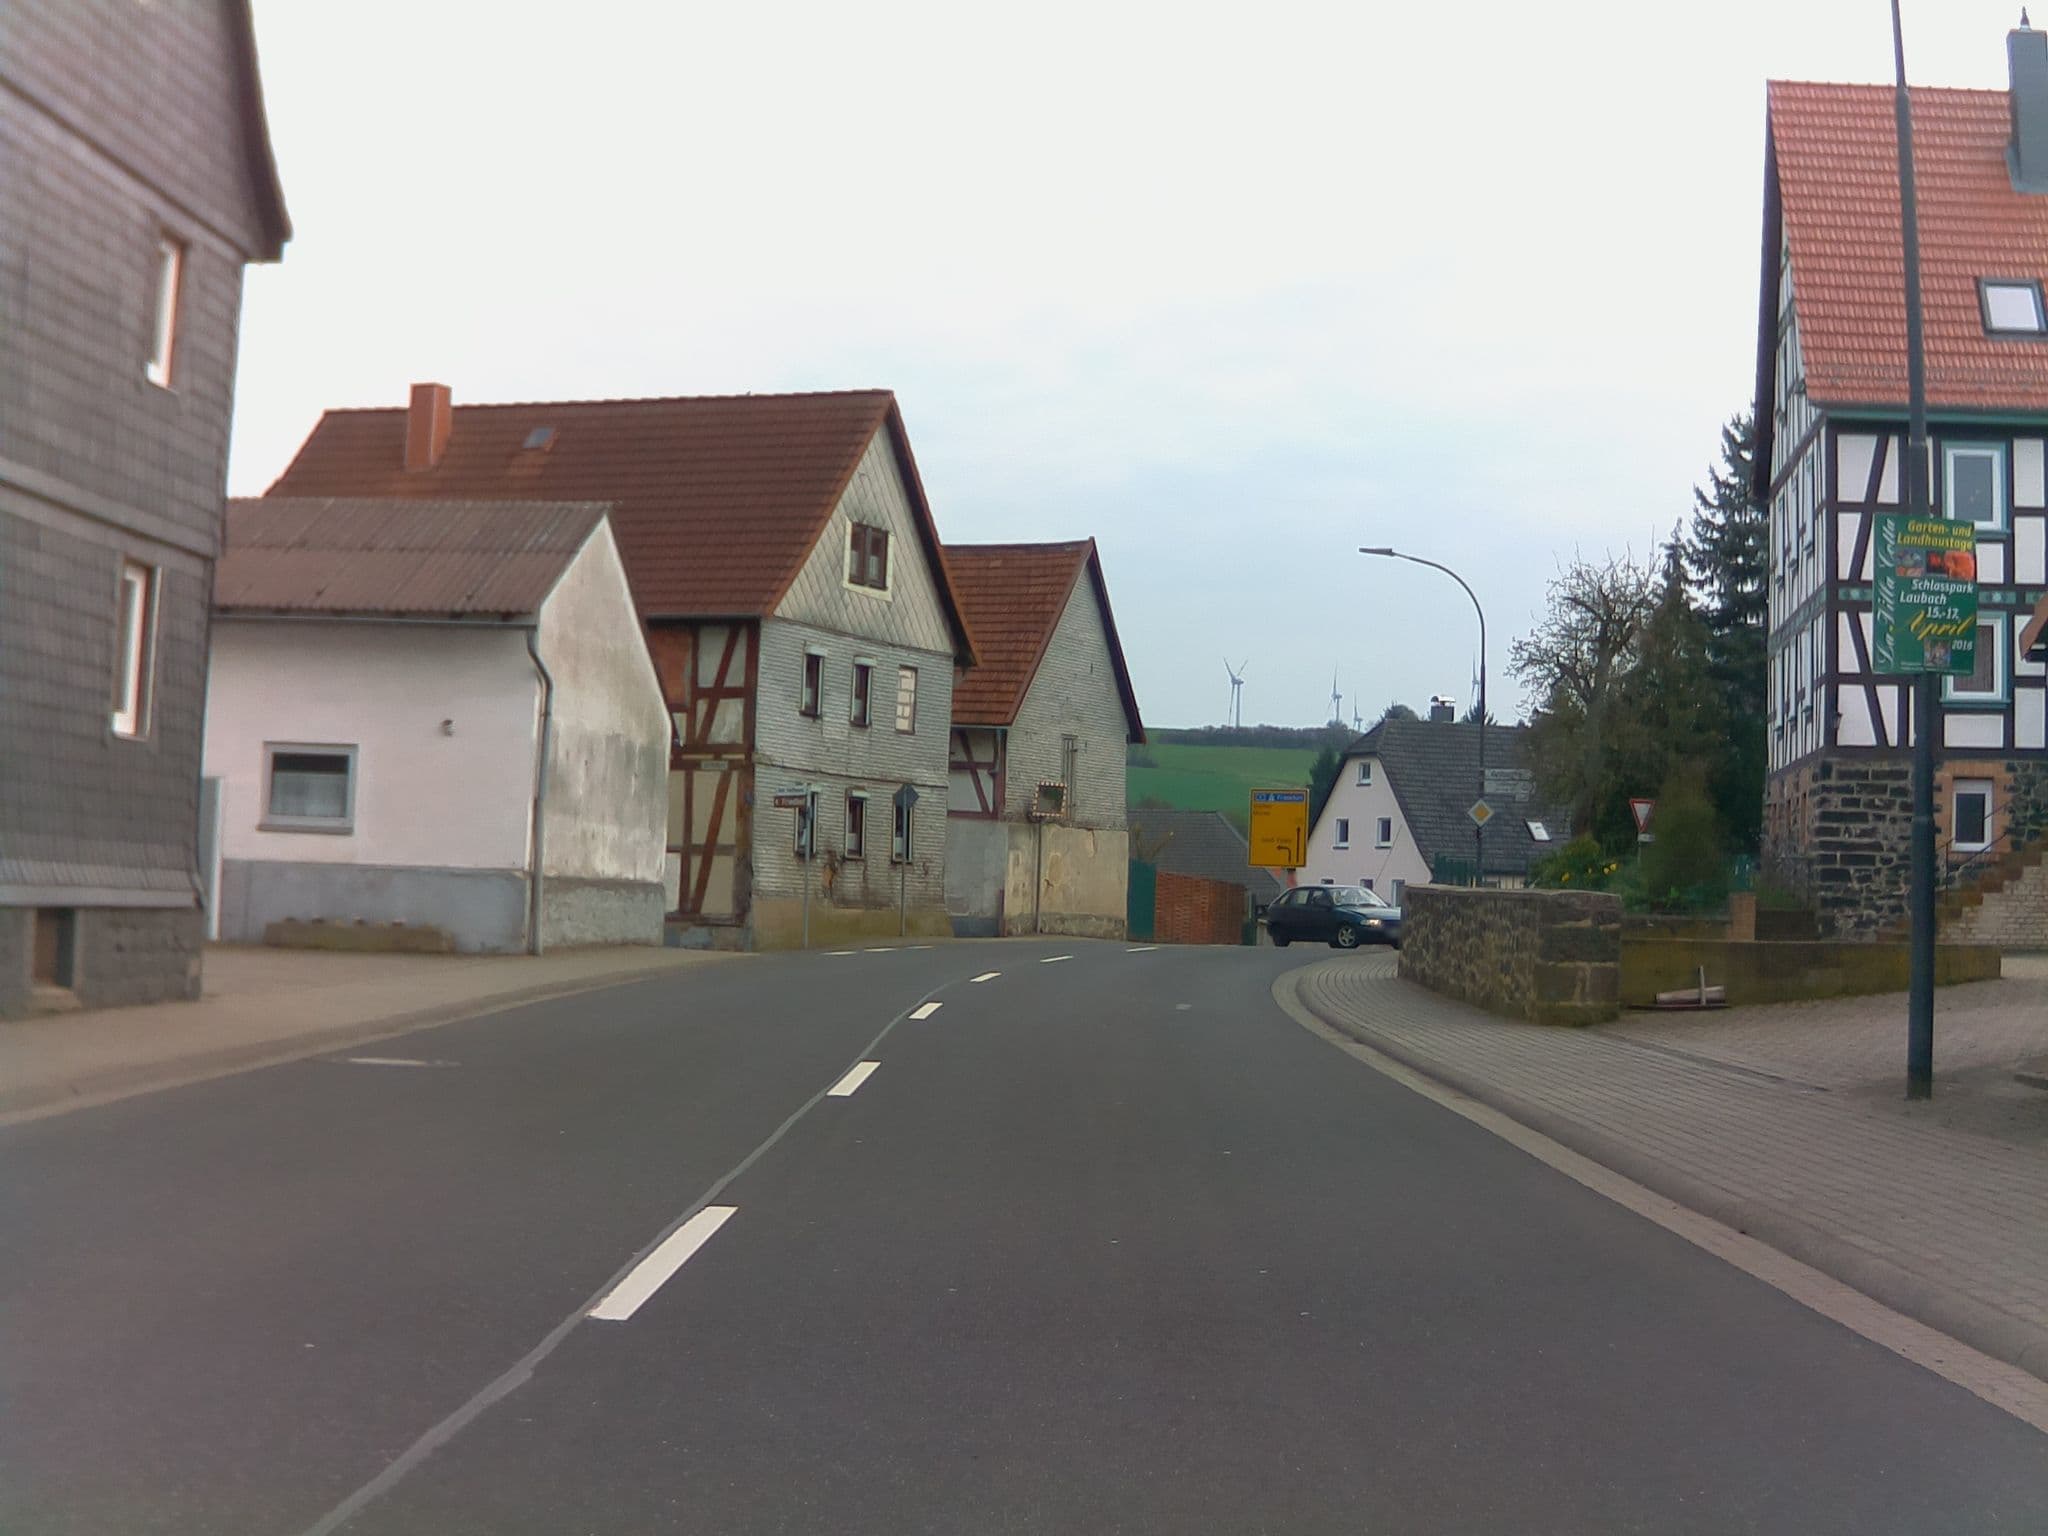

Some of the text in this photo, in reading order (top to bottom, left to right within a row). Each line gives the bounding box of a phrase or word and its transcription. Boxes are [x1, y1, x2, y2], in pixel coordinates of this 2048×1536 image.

[1952, 526, 1972, 537] und
[1911, 578, 1974, 595] Schlosspark
[1899, 591, 1947, 605] Laubach
[1909, 610, 1975, 640] April
